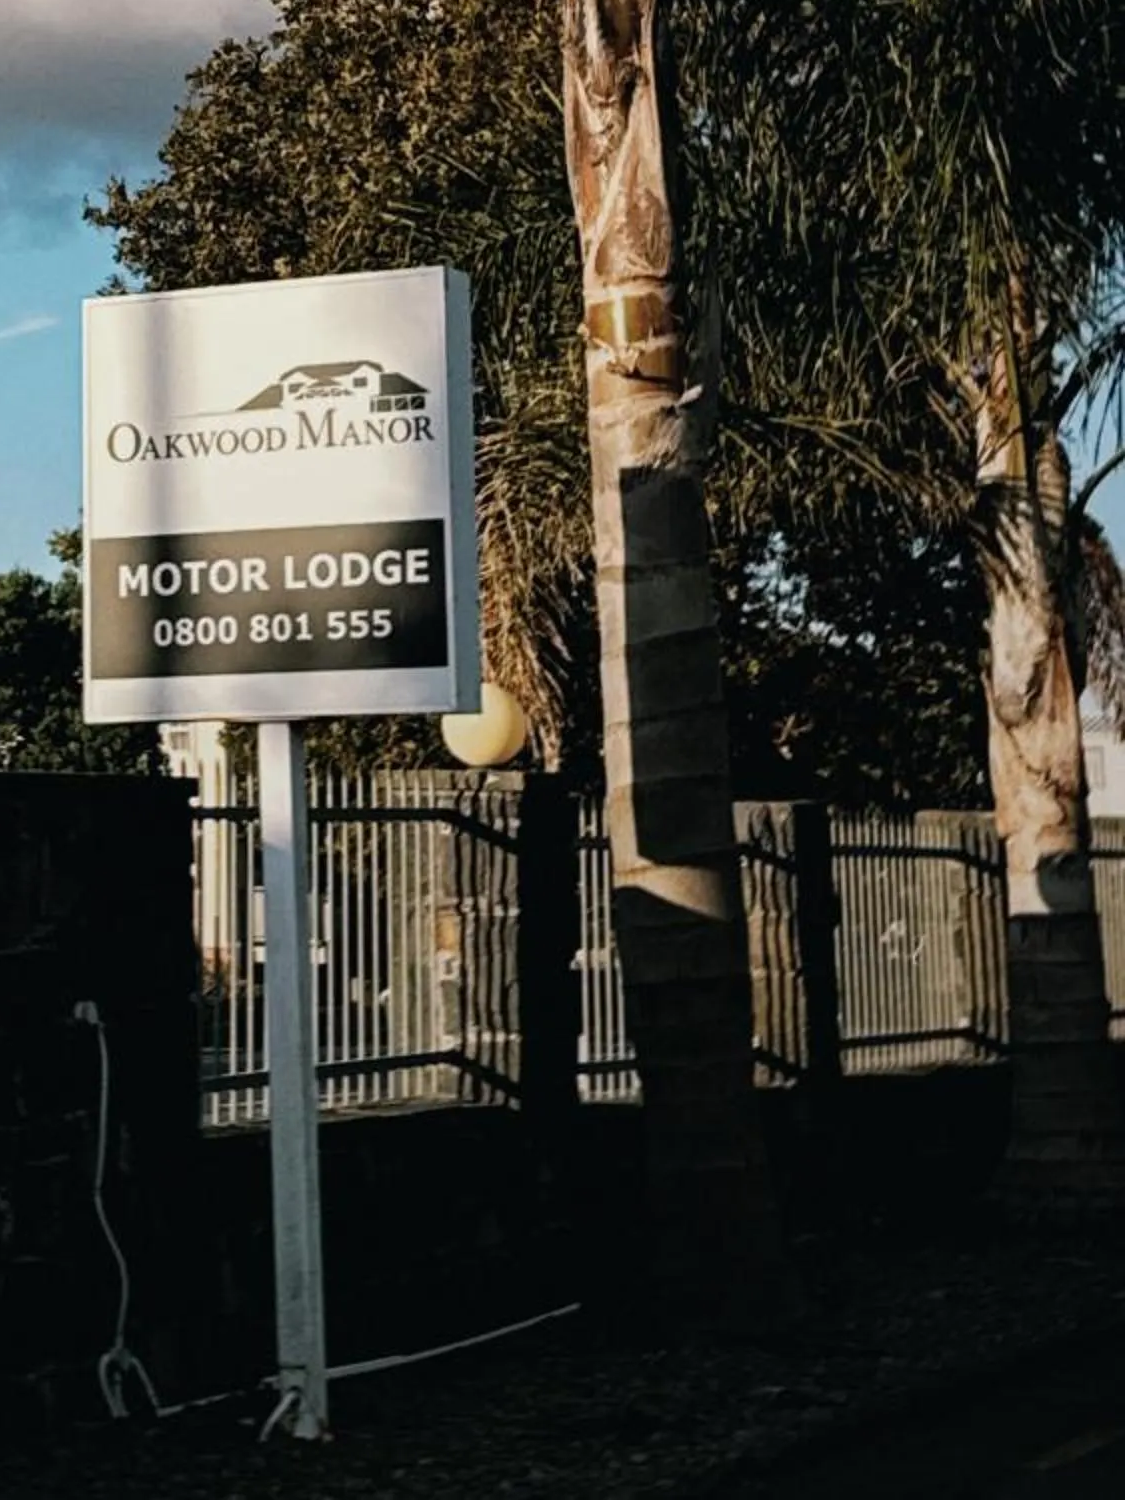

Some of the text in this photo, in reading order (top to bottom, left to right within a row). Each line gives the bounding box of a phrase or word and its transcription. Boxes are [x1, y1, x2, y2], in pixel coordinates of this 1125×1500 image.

[107, 409, 434, 462] OAKWOOD MANOR
[118, 549, 430, 598] MOTOR LODGE
[153, 609, 393, 646] 0800 801 555
